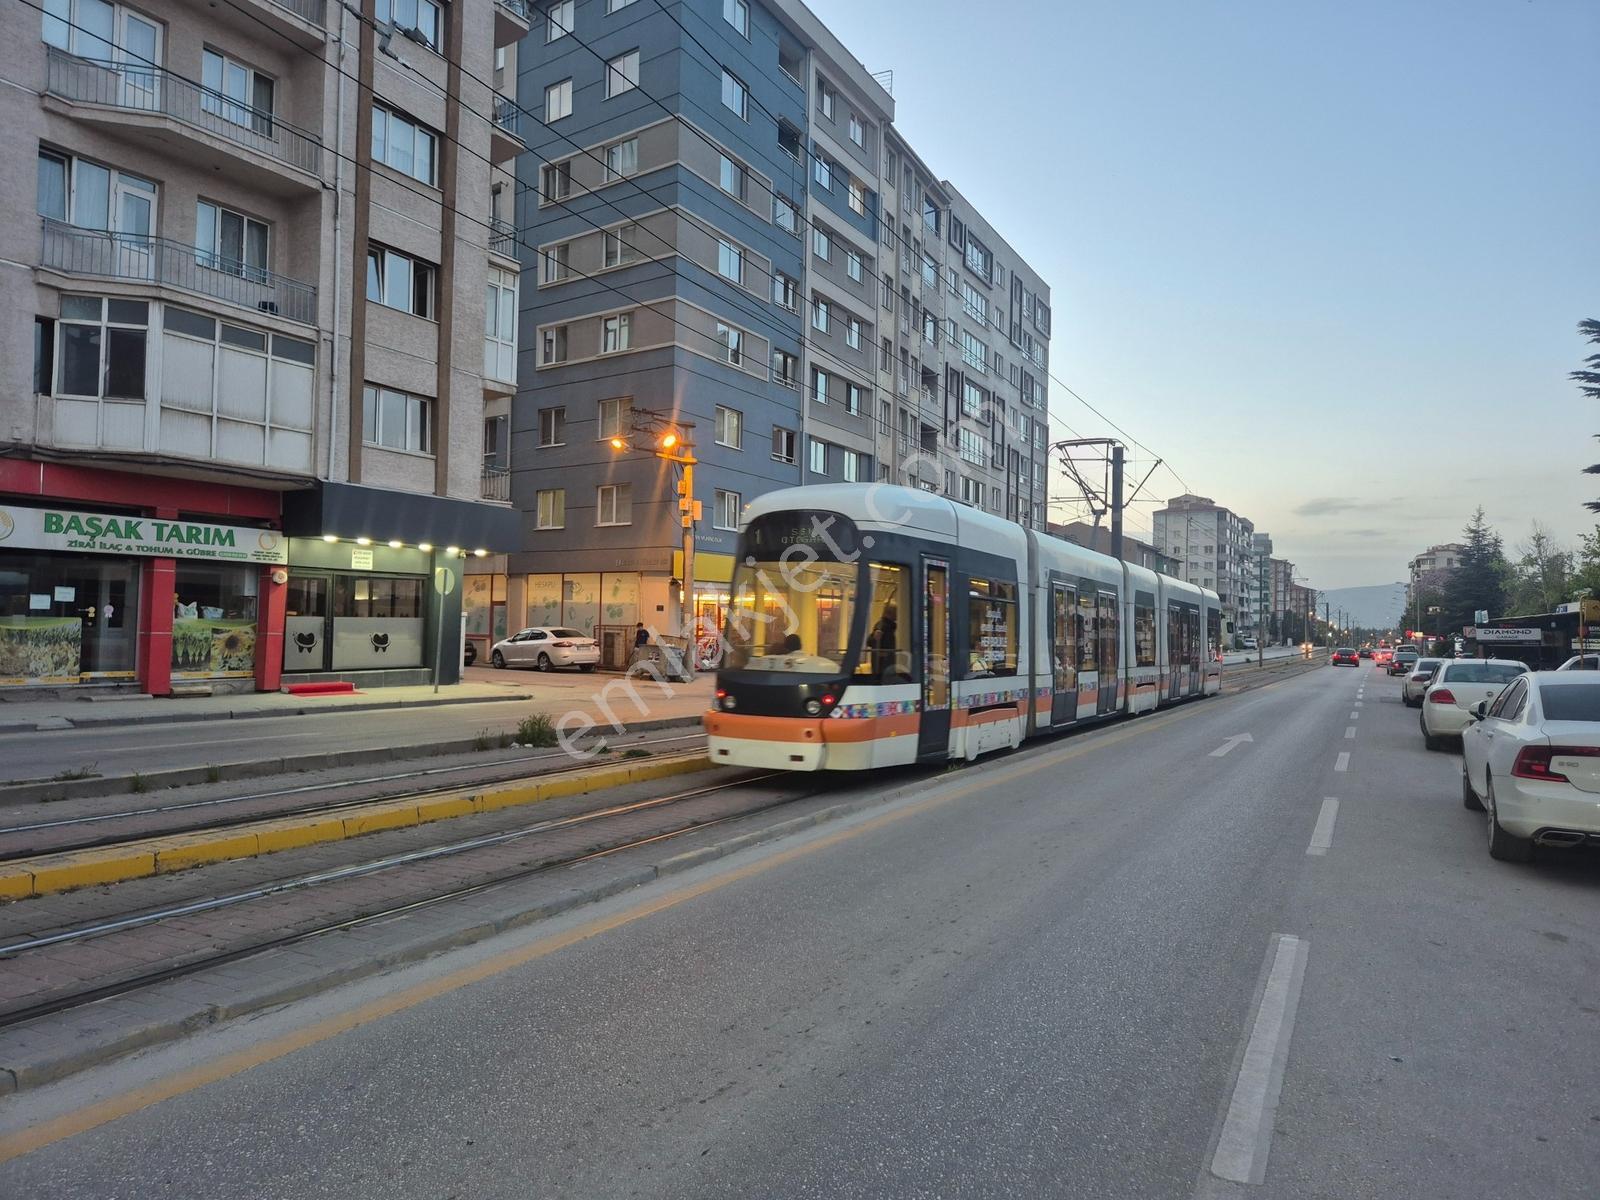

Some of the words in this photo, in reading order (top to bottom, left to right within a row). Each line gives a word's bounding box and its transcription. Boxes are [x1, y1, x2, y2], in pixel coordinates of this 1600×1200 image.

[43, 512, 144, 541] BAŞAK
[151, 522, 236, 547] TARIM
[136, 545, 174, 554] TOHUM
[186, 548, 217, 557] GÜBRE
